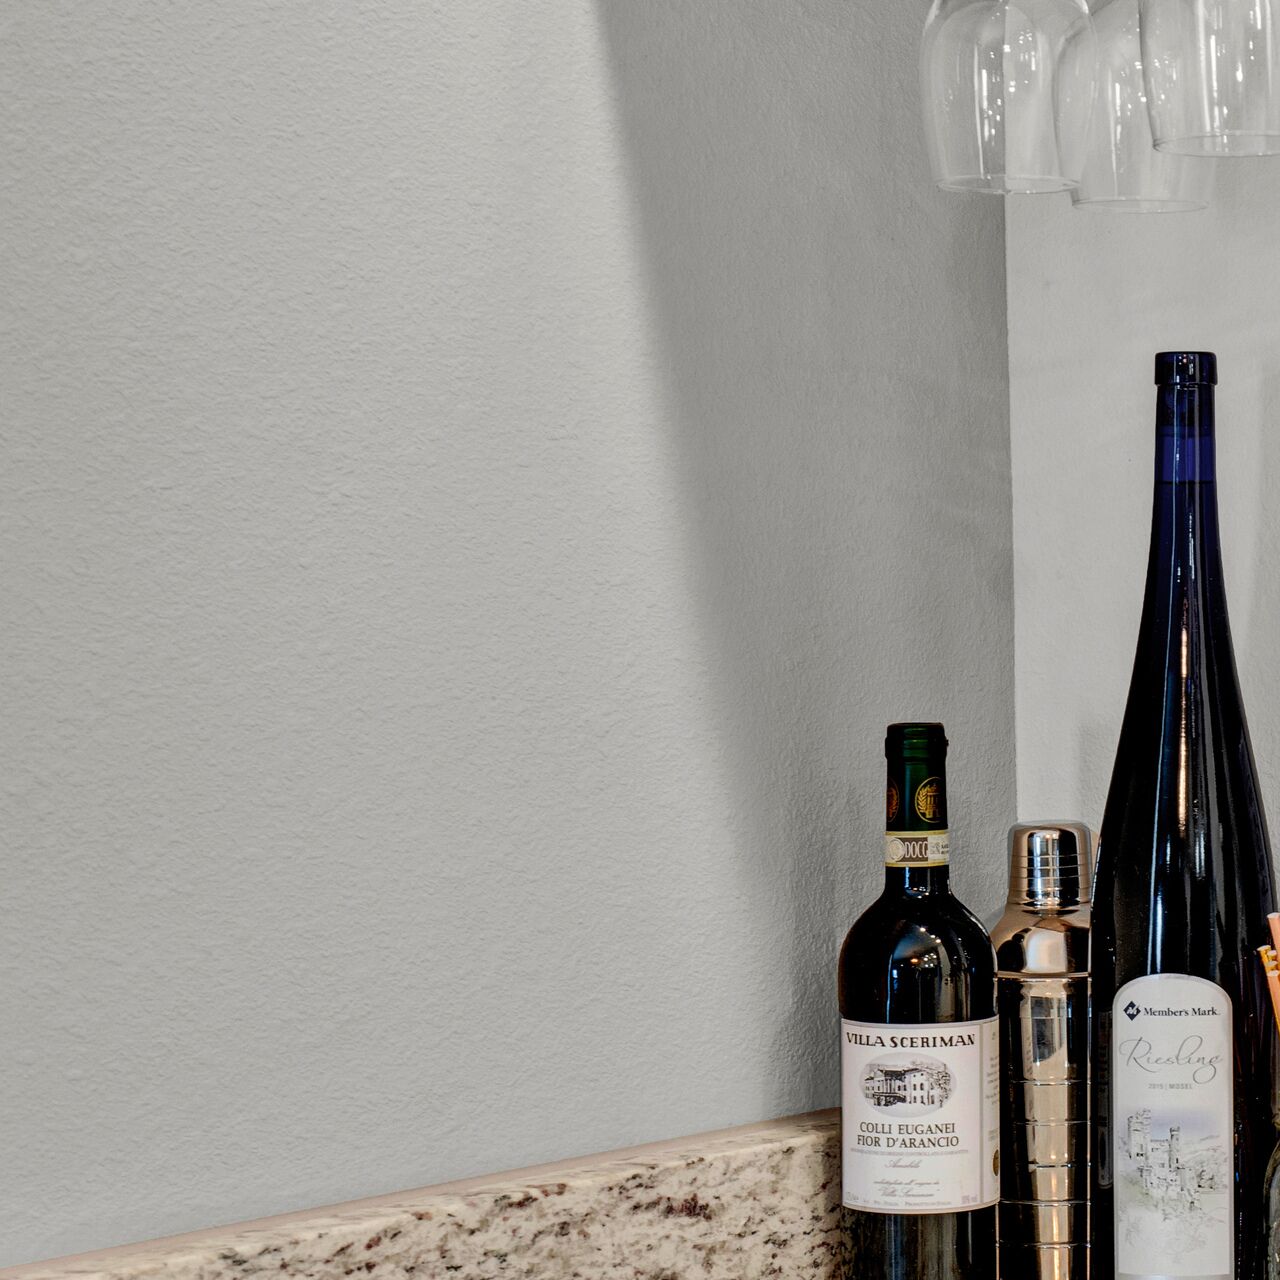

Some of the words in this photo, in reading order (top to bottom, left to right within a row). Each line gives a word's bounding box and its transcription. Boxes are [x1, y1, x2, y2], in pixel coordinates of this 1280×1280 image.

[1143, 1007, 1189, 1017] Member's
[1191, 1007, 1218, 1017] Mark
[846, 1032, 886, 1047] VILLA
[889, 1034, 976, 1048] SCERIMAN
[1119, 1035, 1222, 1084] Riesling
[860, 1122, 892, 1134] COLLI
[898, 1123, 955, 1135] EUGANEI
[857, 1135, 881, 1148] FIOR
[886, 1136, 960, 1149] D'ARANCIO
